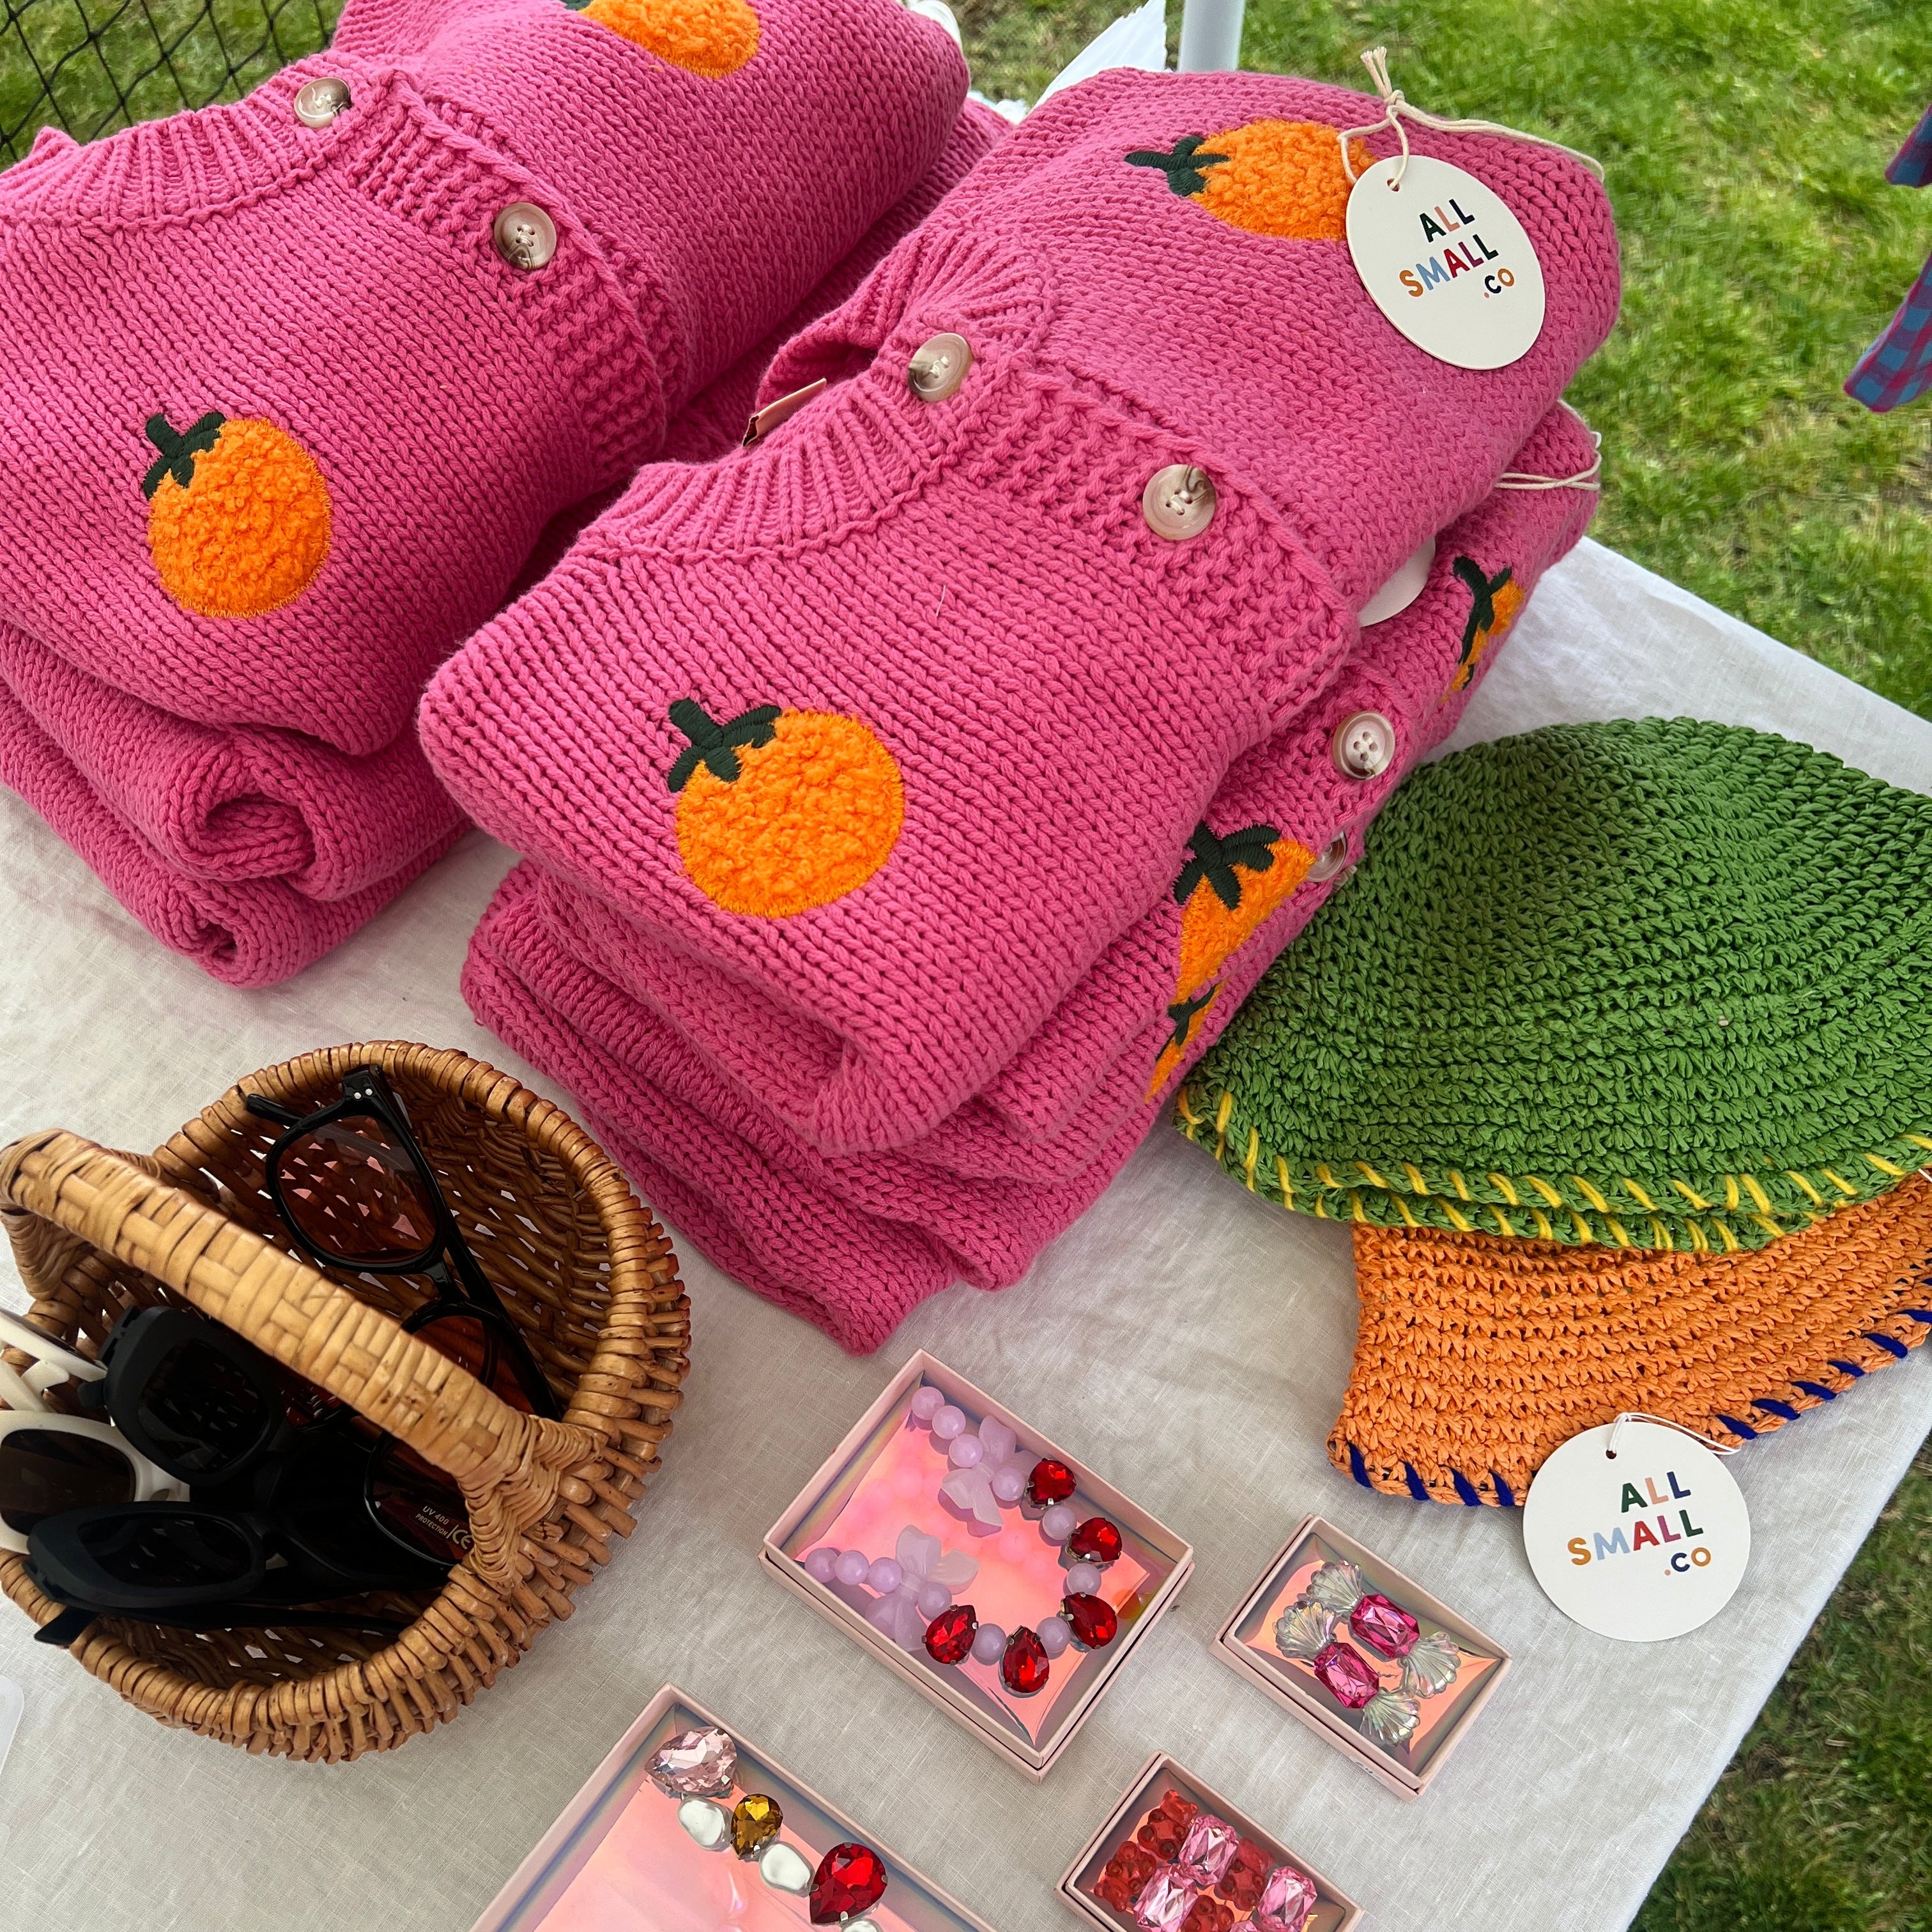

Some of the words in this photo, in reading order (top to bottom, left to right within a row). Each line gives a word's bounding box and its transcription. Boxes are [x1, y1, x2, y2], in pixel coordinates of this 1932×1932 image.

[1419, 198, 1475, 243] ALL
[1399, 234, 1499, 297] SMALL
[1621, 1471, 1691, 1513] ALL
[415, 1513, 448, 1536] PROTECTION
[422, 1506, 436, 1515] UV
[434, 1514, 449, 1525] 400
[1567, 1510, 1704, 1565] SMALL
